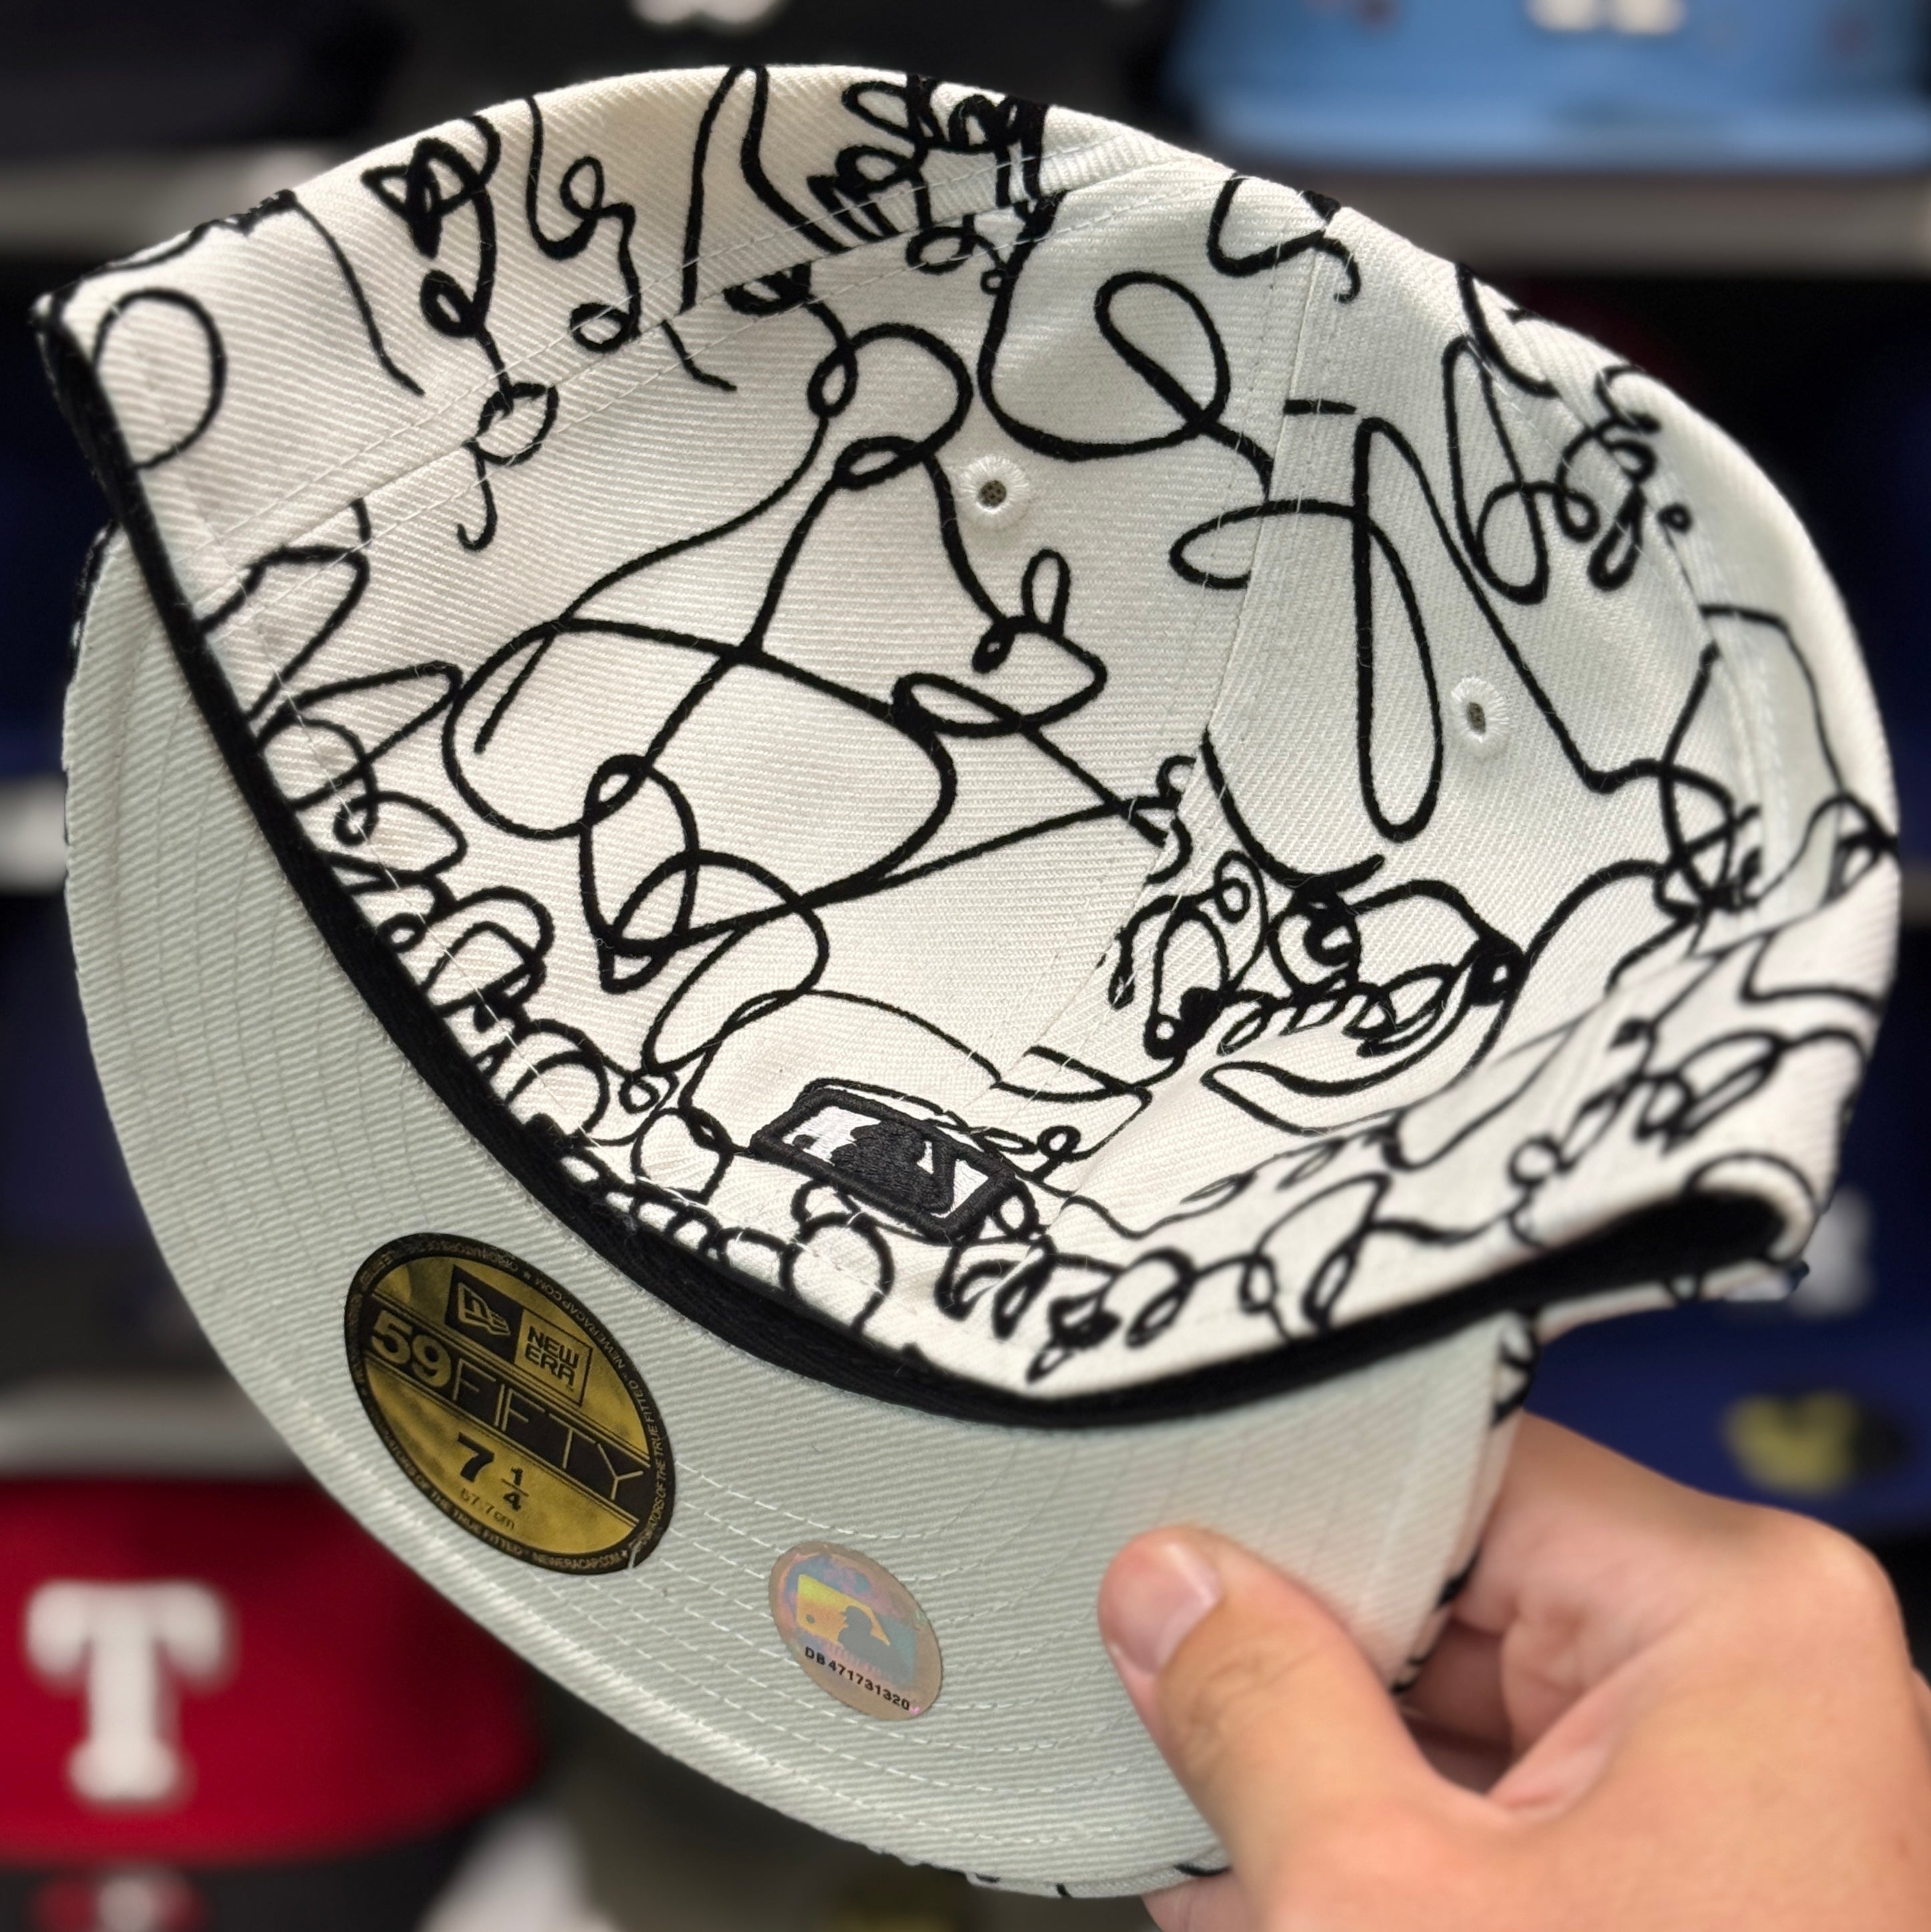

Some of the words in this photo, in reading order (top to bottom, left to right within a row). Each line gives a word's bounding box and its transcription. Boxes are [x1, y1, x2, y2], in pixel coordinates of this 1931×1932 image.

[525, 1342, 576, 1386] ERA
[527, 1325, 580, 1369] NEW
[371, 1310, 644, 1501] 59FIFTY
[458, 1432, 495, 1483] 7
[24, 1578, 228, 1804] T
